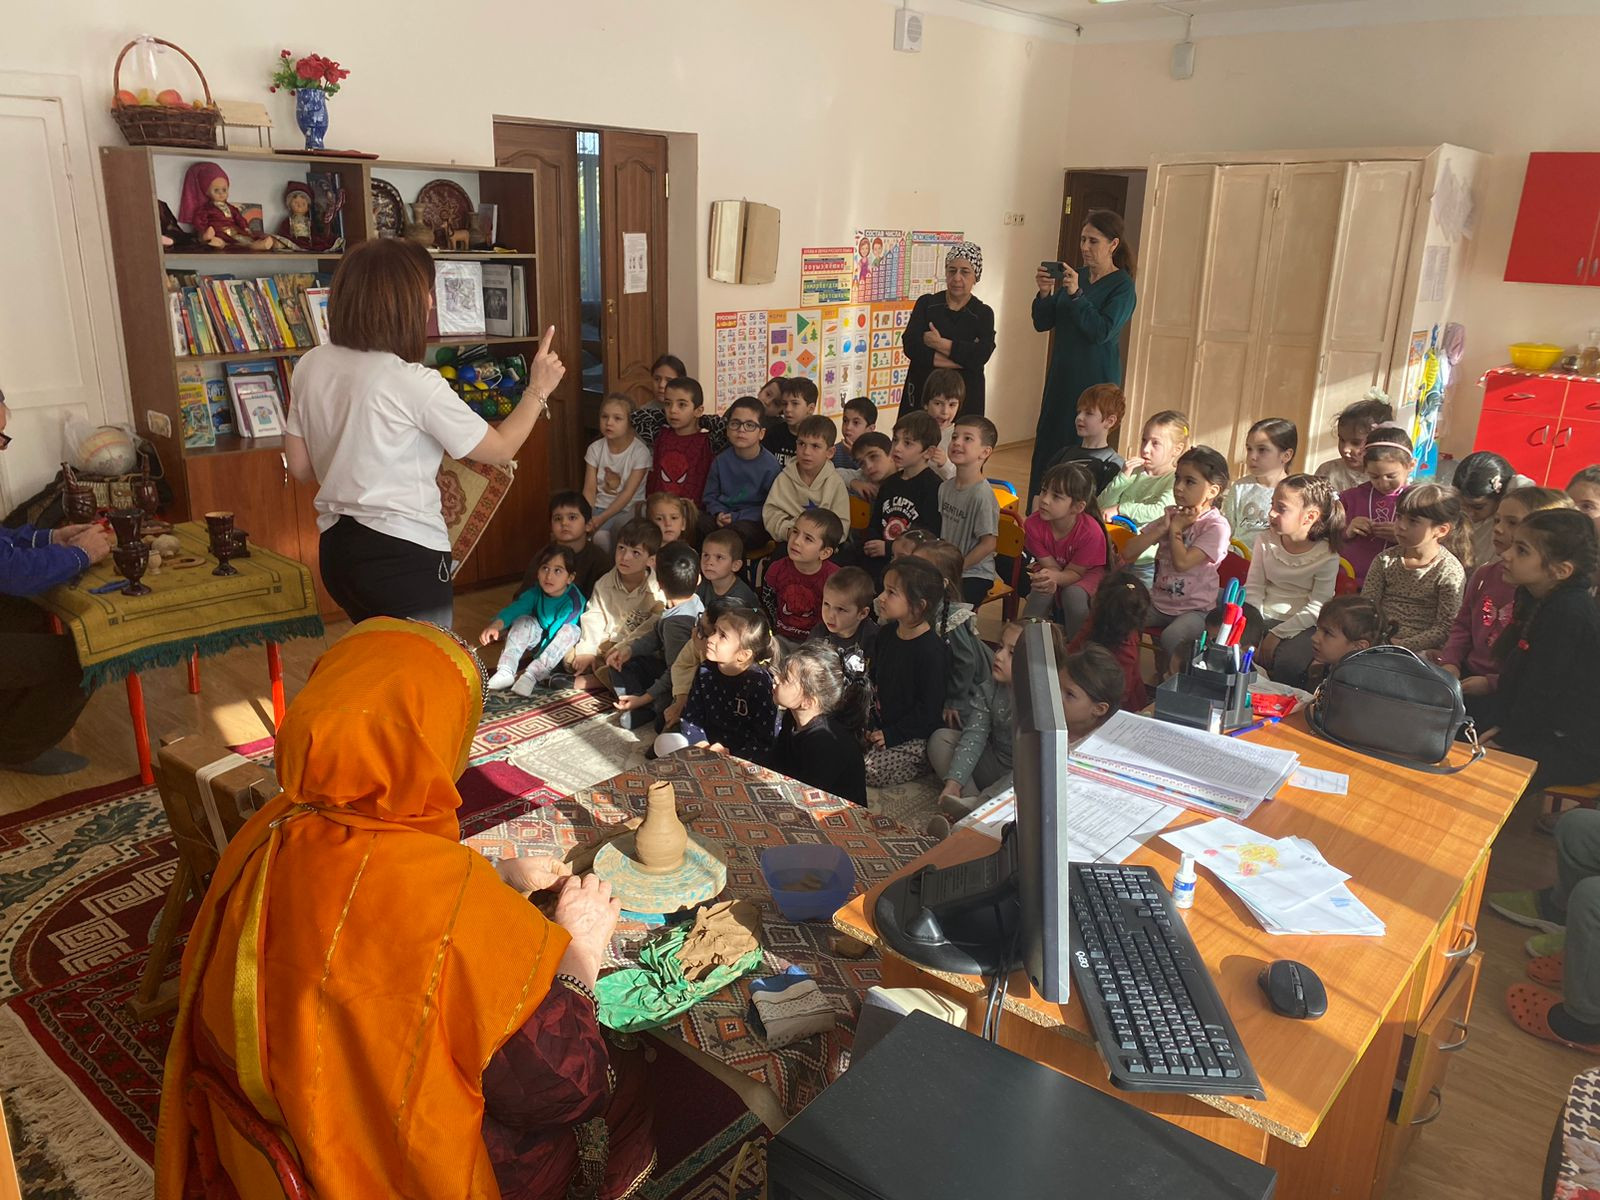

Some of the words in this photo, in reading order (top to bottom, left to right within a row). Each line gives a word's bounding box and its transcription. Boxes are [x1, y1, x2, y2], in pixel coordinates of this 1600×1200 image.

[874, 313, 879, 328] 1
[896, 312, 902, 326] 6
[873, 333, 880, 348] 2
[895, 332, 902, 345] 7
[872, 353, 878, 367] 3
[894, 351, 900, 365] 8
[871, 372, 877, 387] 4
[893, 370, 899, 384] 9
[871, 392, 877, 404] 5
[891, 388, 901, 403] 10
